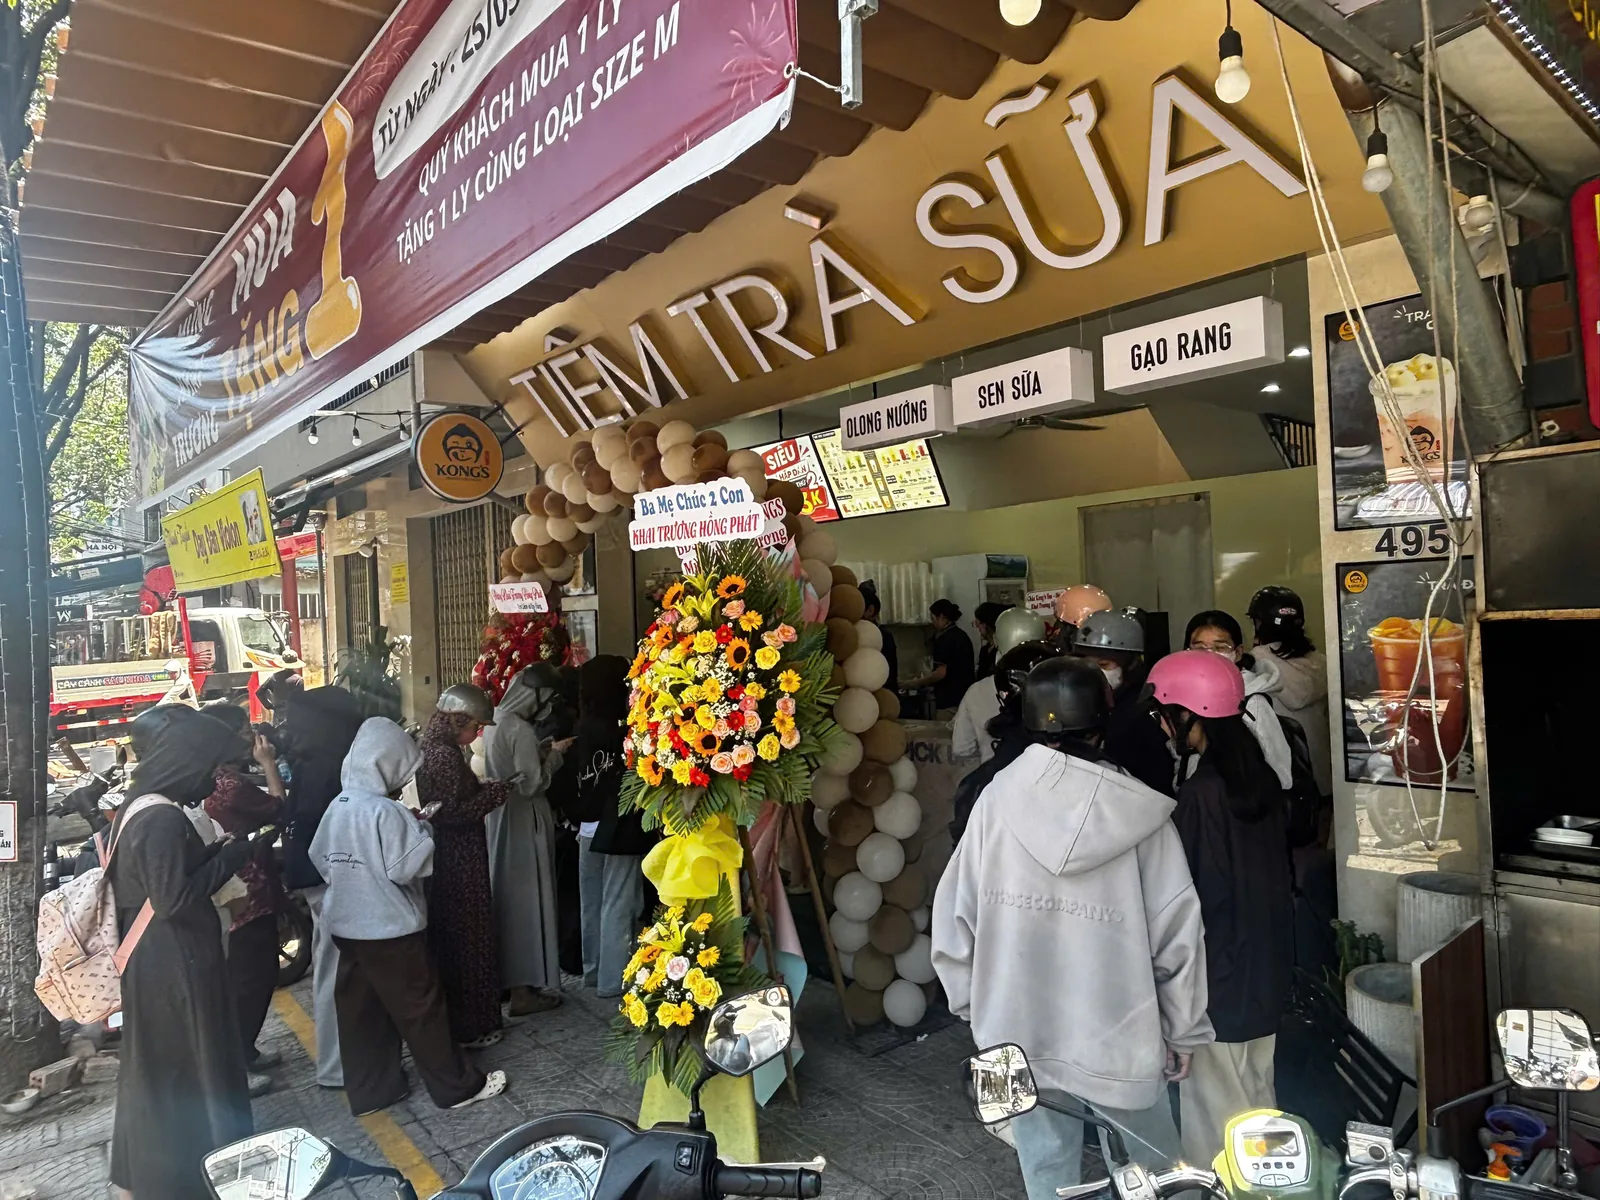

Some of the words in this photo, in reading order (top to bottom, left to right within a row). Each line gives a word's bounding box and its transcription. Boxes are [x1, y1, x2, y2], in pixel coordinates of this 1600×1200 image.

[418, 134, 450, 196] QUÝ
[453, 82, 514, 160] KHÁCH
[520, 38, 569, 107] MUA
[577, 14, 588, 53] 1
[597, 0, 622, 39] LY
[378, 105, 400, 154] TỪ
[396, 209, 435, 265] TẶNG
[438, 198, 448, 230] 1
[451, 183, 472, 221] LY
[474, 132, 527, 202] CÙNG
[533, 81, 585, 158] LOẠI
[590, 30, 646, 110] SIZE
[653, 1, 680, 60] M
[231, 187, 297, 315] MUA
[667, 205, 916, 383] TRÀ
[915, 74, 1308, 304] SỮA
[221, 288, 304, 430] TẶNG
[1130, 337, 1168, 372] GẠO
[1177, 322, 1232, 361] RANG
[977, 379, 1005, 409] SEN
[1011, 370, 1042, 401] SỮA
[846, 410, 881, 439] OLONG
[887, 398, 927, 430] NƯỚNG
[766, 444, 796, 471] SIÊU
[640, 498, 655, 516] Ba
[658, 494, 674, 518] Mẹ
[675, 490, 707, 510] Chúc
[708, 490, 717, 507] 2
[719, 486, 745, 505] Con
[632, 526, 656, 546] KHAI
[657, 521, 697, 543] TRƯƠNG
[699, 511, 727, 538] HỒNG
[729, 509, 760, 533] PHÁT
[1375, 524, 1451, 558] 495
[907, 741, 942, 764] ICK
